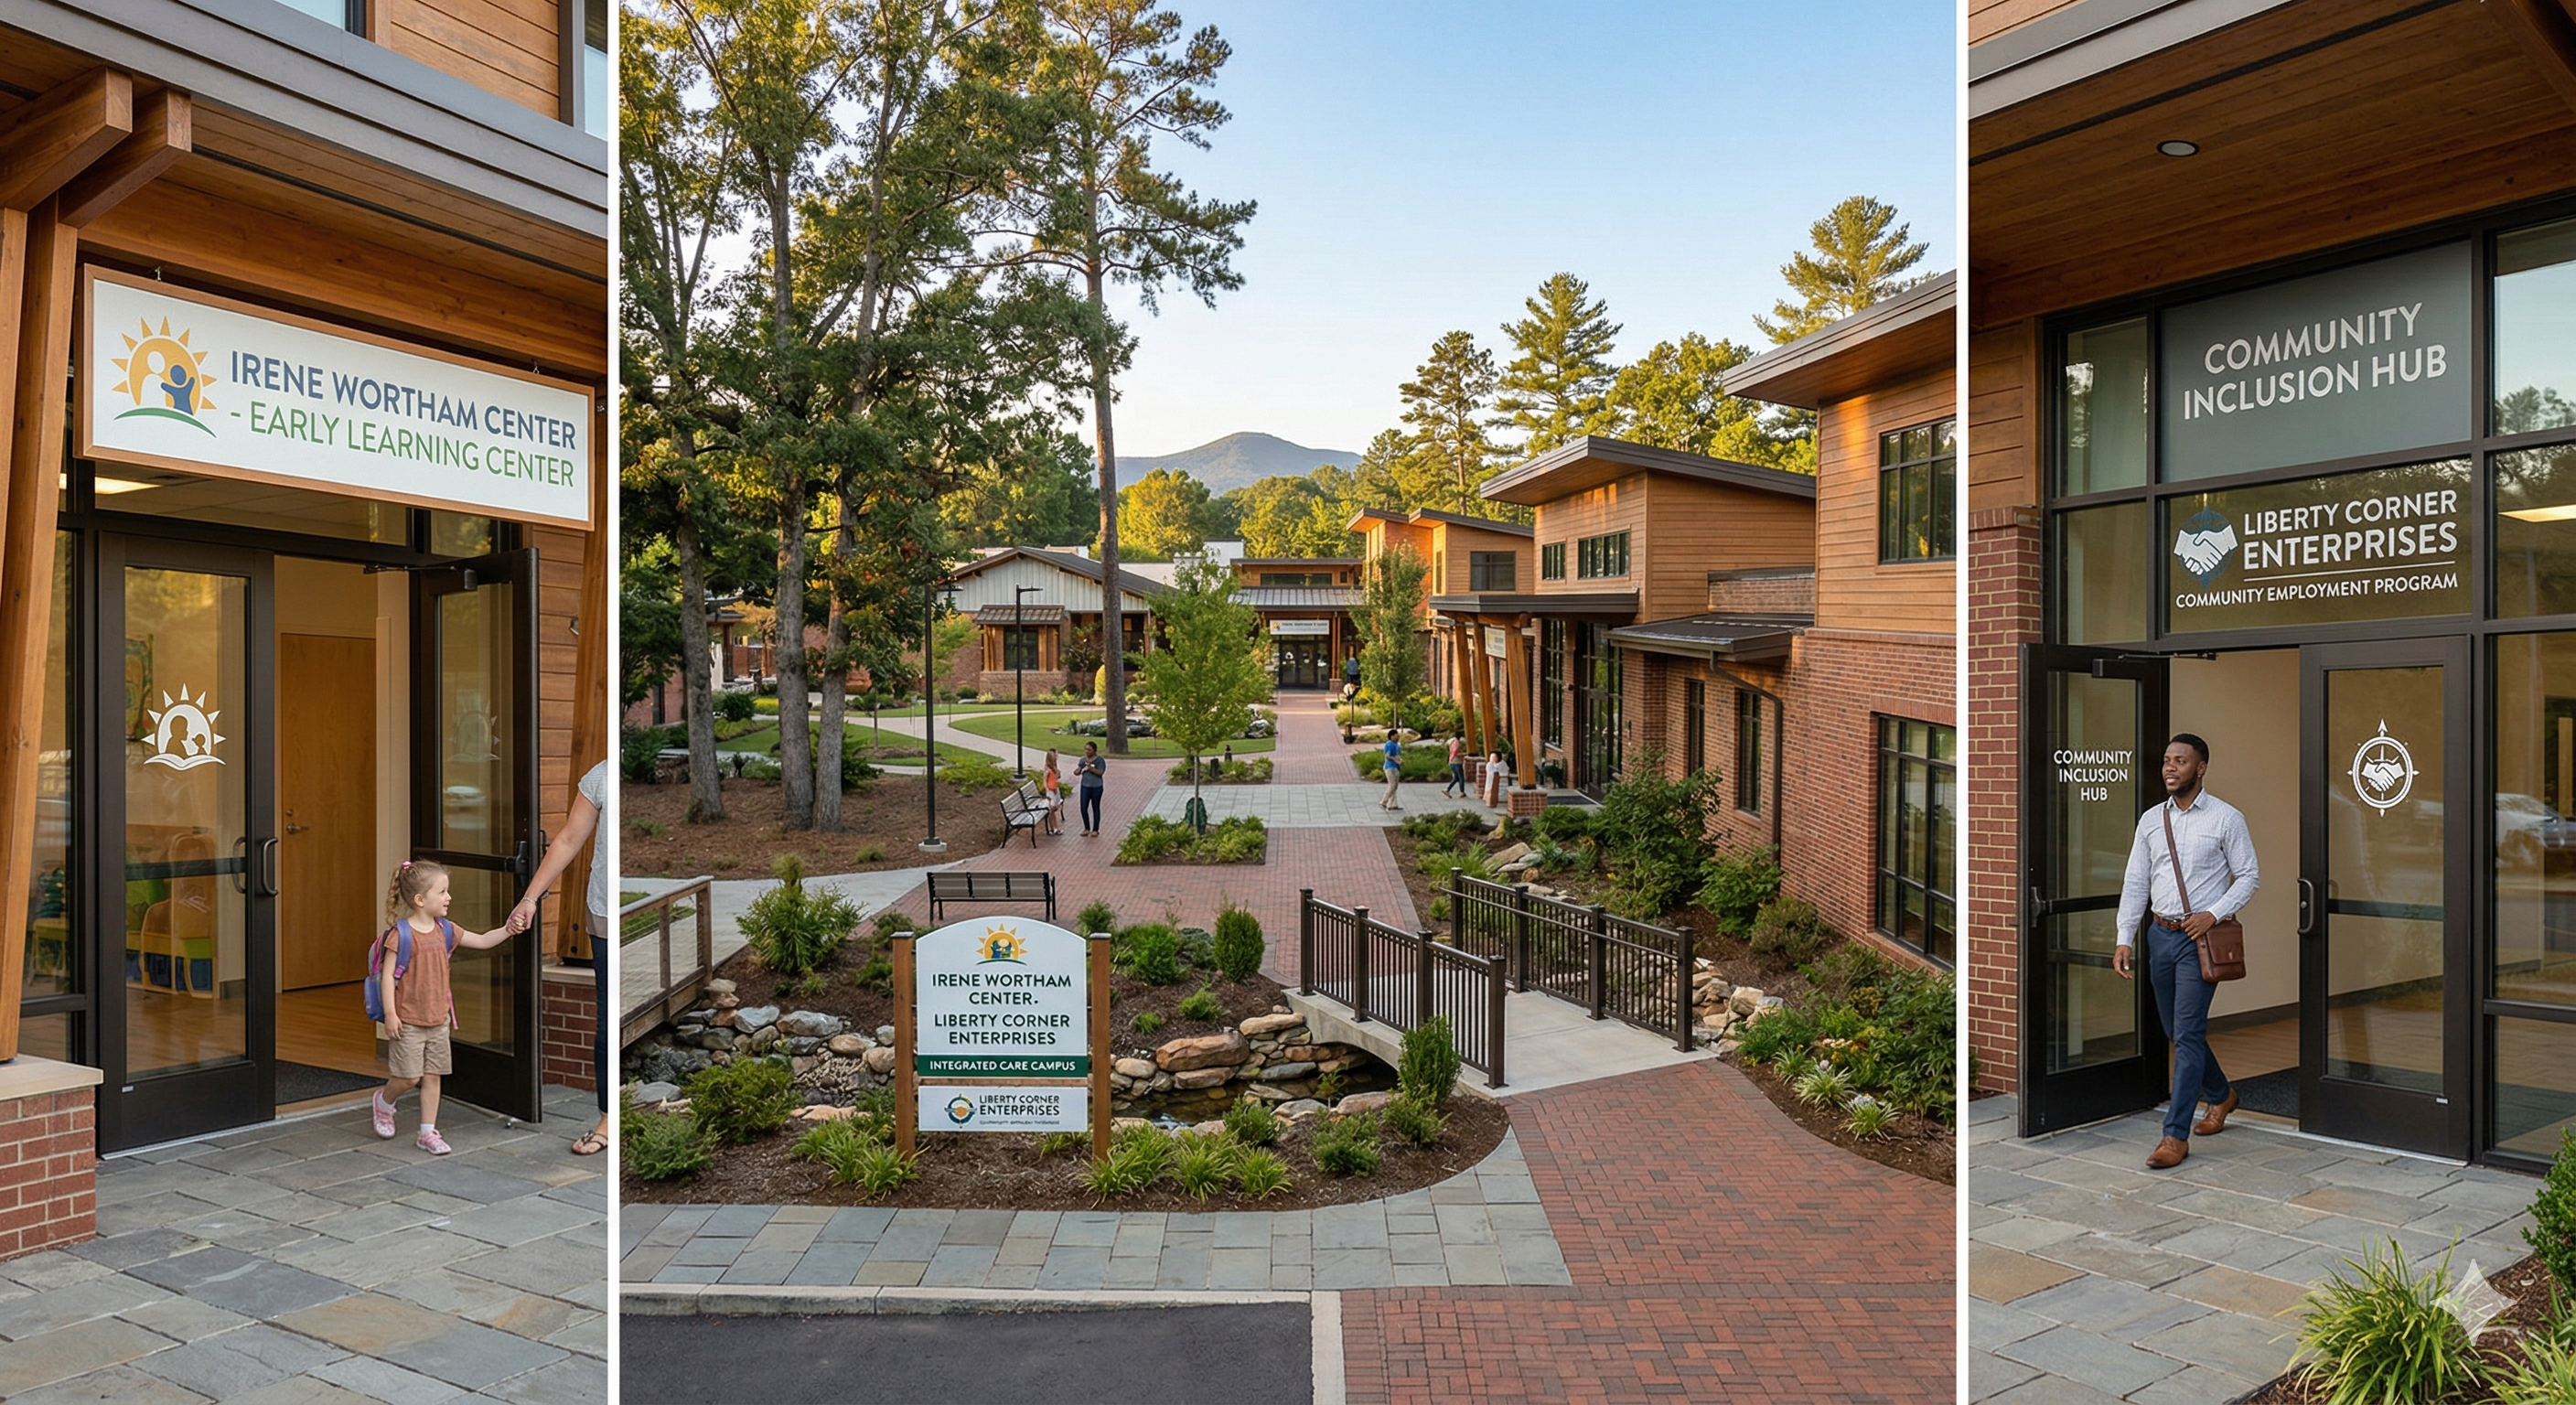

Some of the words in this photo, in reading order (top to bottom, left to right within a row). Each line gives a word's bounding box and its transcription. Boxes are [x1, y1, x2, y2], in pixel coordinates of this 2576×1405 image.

[2205, 302, 2423, 374] COMMUNITY
[2184, 359, 2359, 420] INCLUSION
[2372, 344, 2447, 388] HUB
[231, 350, 324, 400] IRENE
[331, 371, 478, 431] WORTHAM
[484, 405, 576, 450] CENTER
[250, 401, 340, 445] EARLY
[348, 420, 479, 472] LEARNING
[486, 445, 574, 488] CENTER
[2244, 503, 2340, 536] LIBERTY
[2345, 489, 2457, 524] CORNER
[2244, 521, 2458, 570] ENTERPRISES
[2175, 587, 2264, 608] COMMUNITY
[2267, 579, 2371, 602] EMPLOYMENT
[2375, 572, 2458, 594] PROGRAM
[2054, 749, 2132, 765] COMMUNITY
[2059, 767, 2128, 783] INCLUSION
[2080, 787, 2108, 801] HUB
[932, 973, 981, 987] IRENE
[984, 973, 1071, 988] WORTHAM
[934, 1014, 998, 1027] LIBERTY
[1002, 1014, 1070, 1028] CORNER
[949, 1031, 1057, 1046] ENTERPRISES
[929, 1060, 997, 1071] INTEGRATED
[999, 1060, 1028, 1071] CARE
[1030, 1060, 1076, 1071] CAMPUS
[979, 1095, 1017, 1104] LIBERTY
[1018, 1095, 1060, 1104] CORNER
[979, 1104, 1060, 1116] ENTERPRISES
